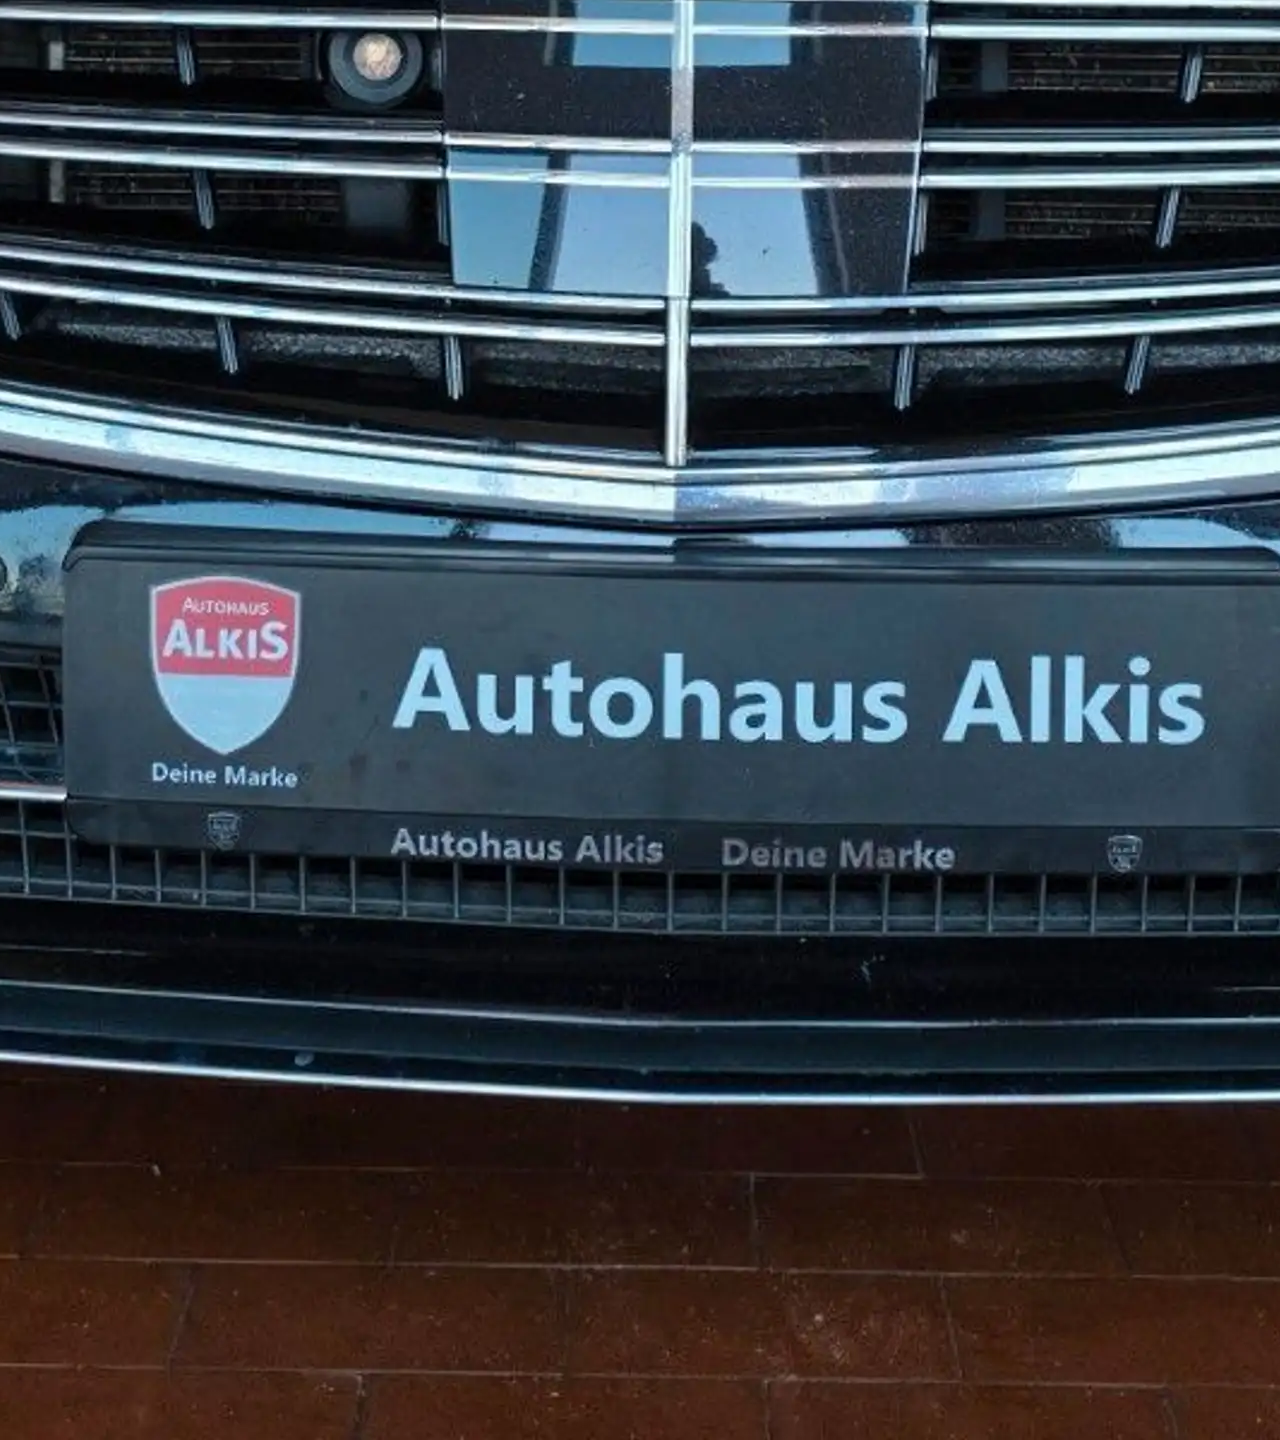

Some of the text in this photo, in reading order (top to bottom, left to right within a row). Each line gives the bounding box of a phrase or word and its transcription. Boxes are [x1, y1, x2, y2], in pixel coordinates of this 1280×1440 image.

[182, 596, 270, 615] AUTOHAUS
[162, 619, 289, 661] ALKIS
[391, 646, 1206, 746] Autohaus Alkis
[151, 762, 299, 789] Deine Marke
[390, 826, 956, 871] Autohaus Alkis Deine Marke
